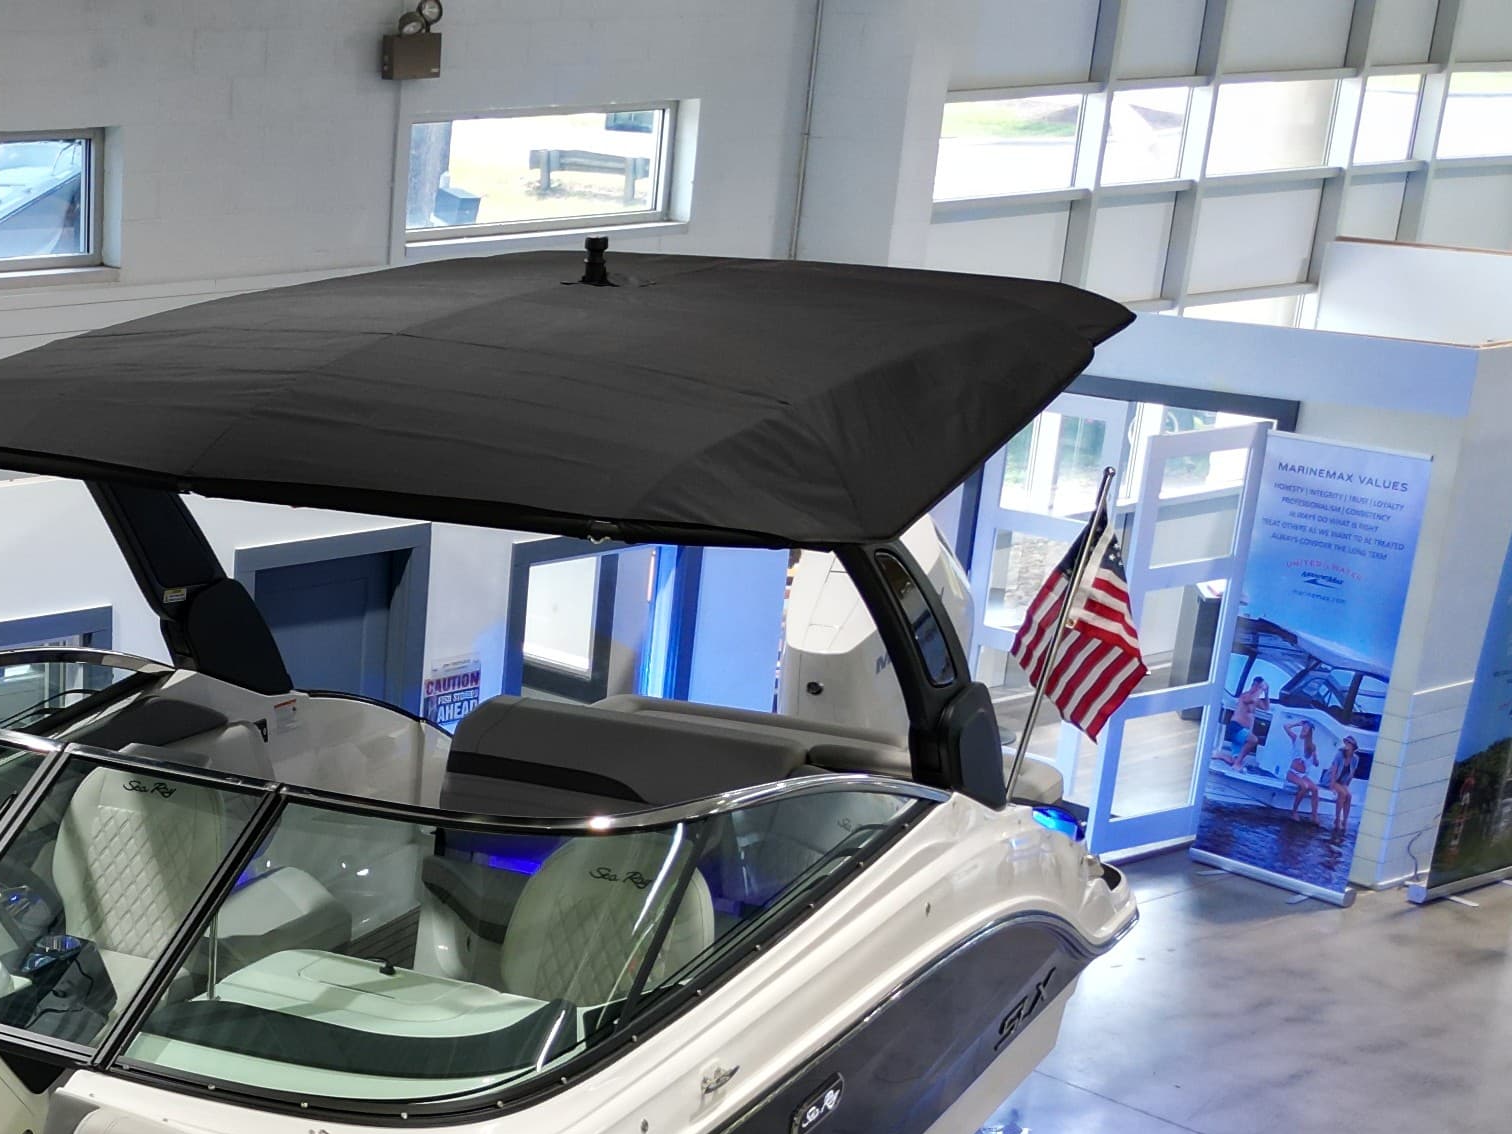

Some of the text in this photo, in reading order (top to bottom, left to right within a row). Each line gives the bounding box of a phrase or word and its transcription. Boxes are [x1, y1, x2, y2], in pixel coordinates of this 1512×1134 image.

[1278, 462, 1409, 492] MARINEMAX VALUES
[1373, 499, 1405, 512] LOYALTY
[426, 670, 479, 696] CAUTION
[123, 780, 177, 798] Sea Ray
[589, 866, 653, 889] Sea Ray
